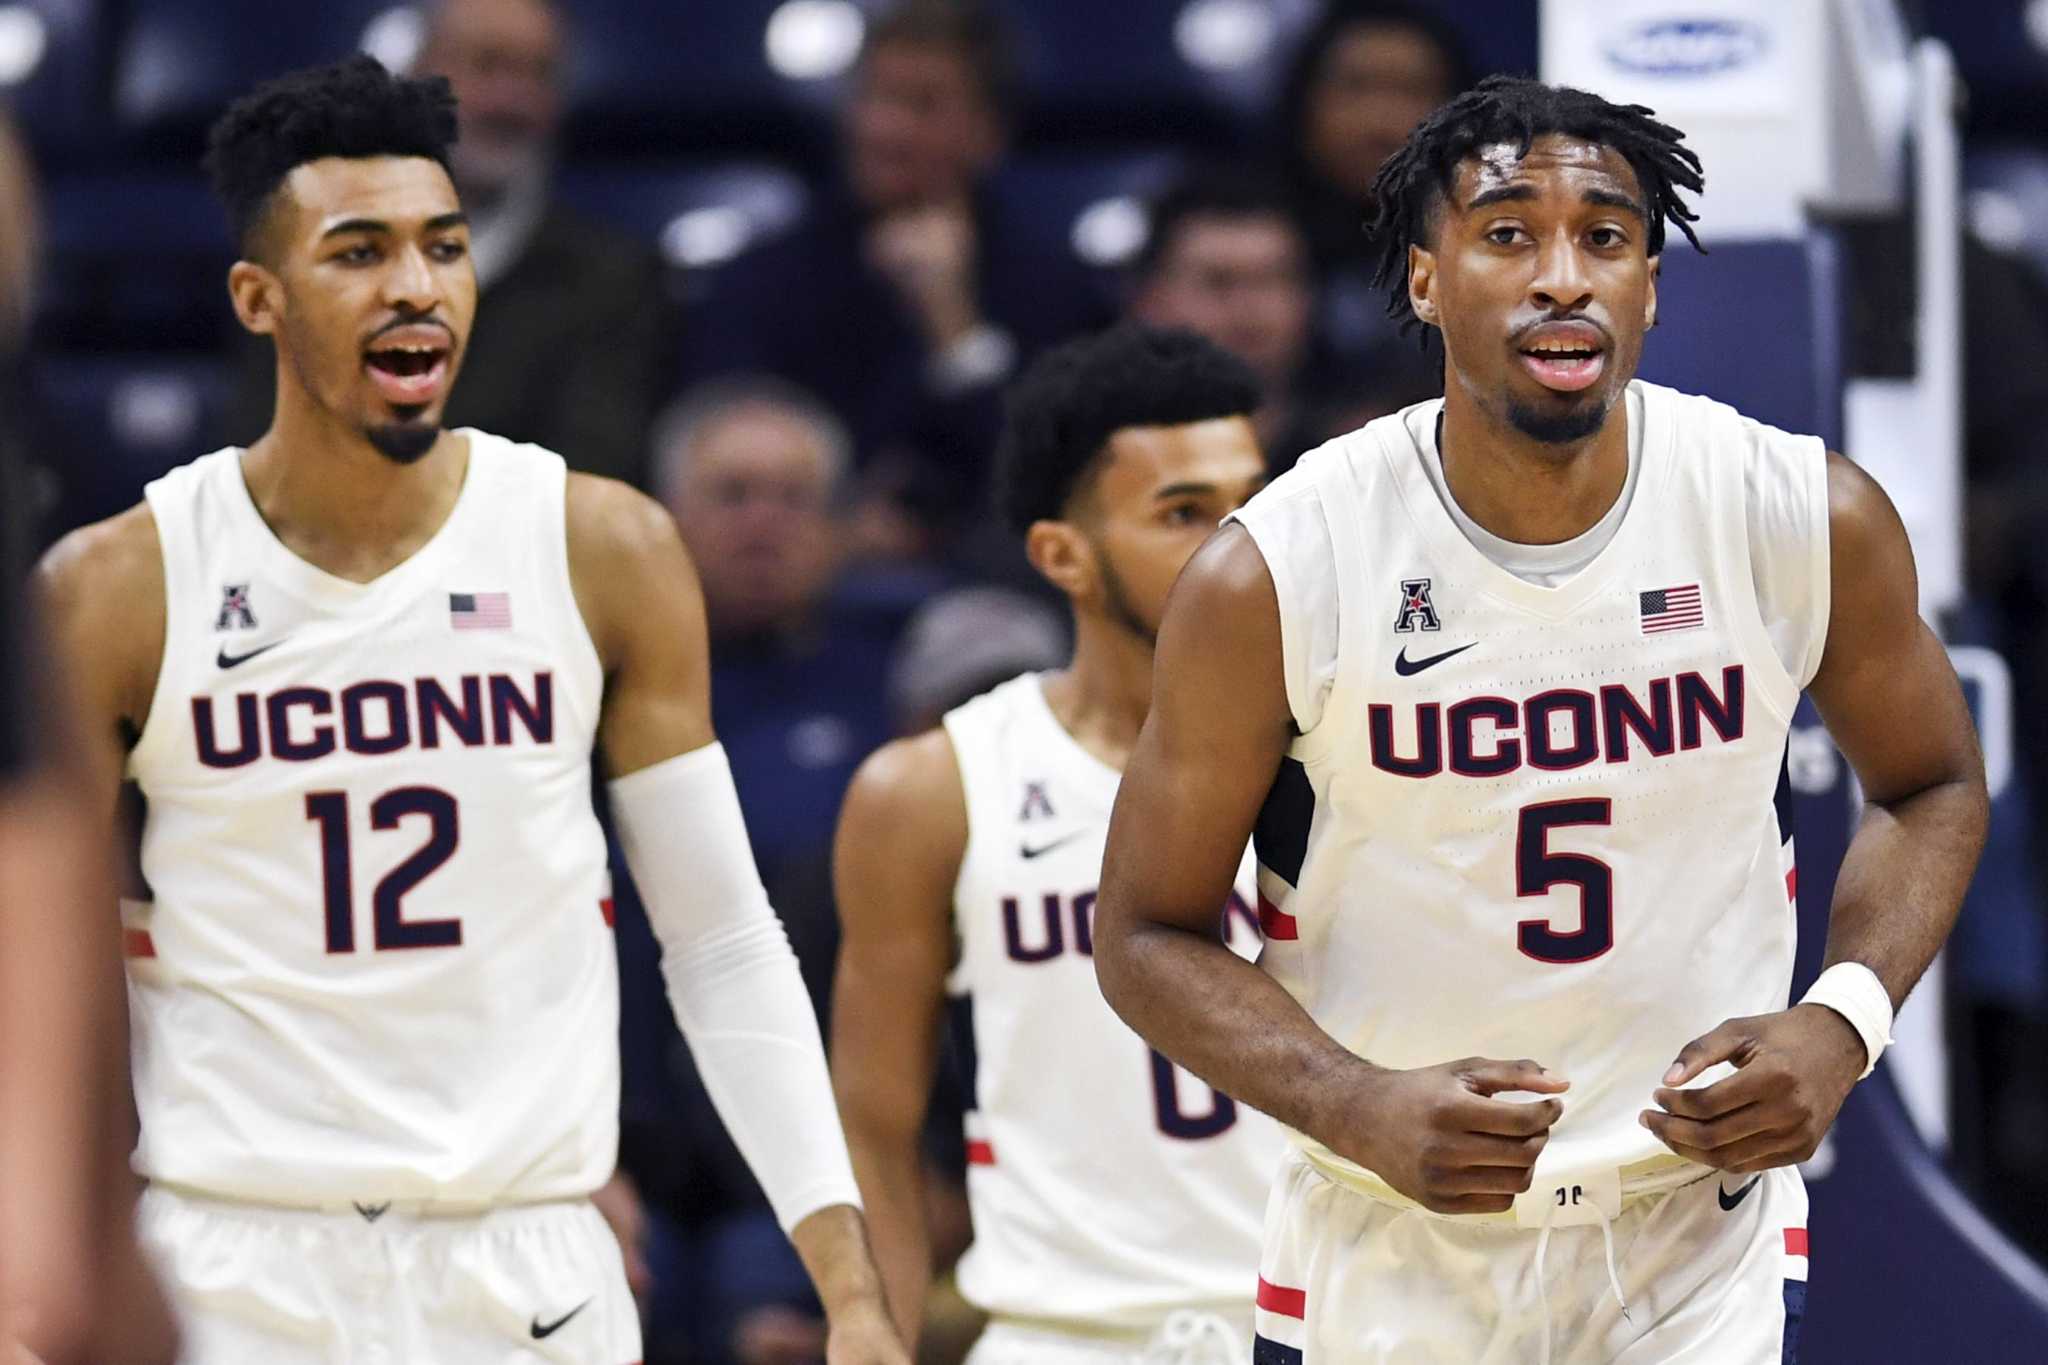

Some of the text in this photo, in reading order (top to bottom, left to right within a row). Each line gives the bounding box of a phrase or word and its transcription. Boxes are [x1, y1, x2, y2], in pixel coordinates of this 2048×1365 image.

[190, 671, 554, 770] UCONN
[1367, 664, 1745, 779] UCONN
[303, 785, 463, 955] 12
[1515, 796, 1614, 965] 5
